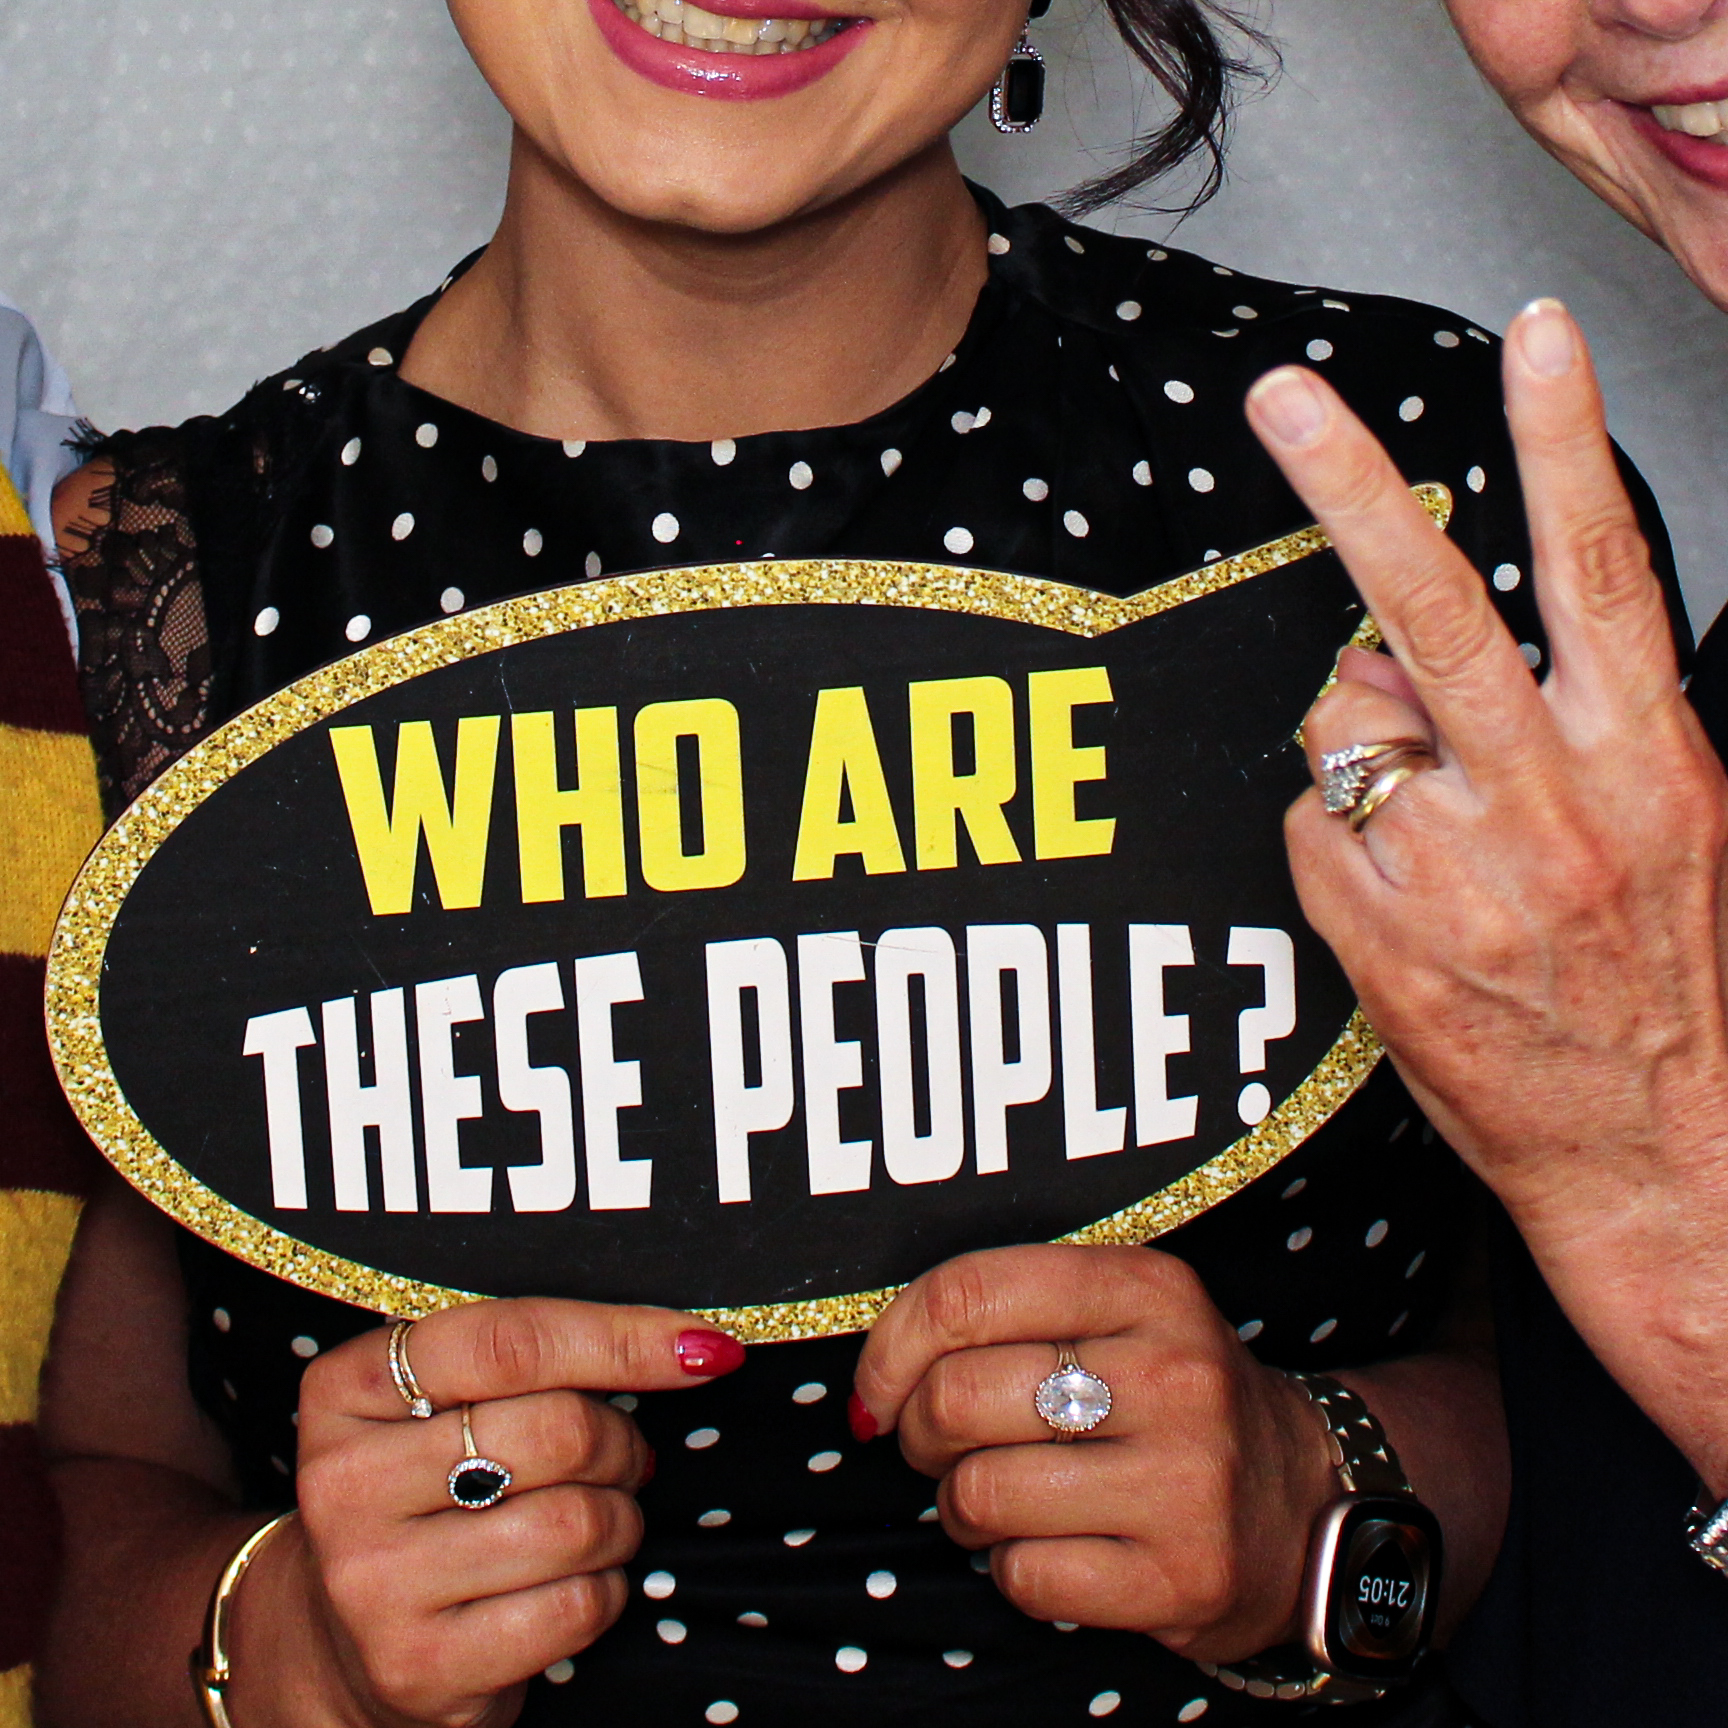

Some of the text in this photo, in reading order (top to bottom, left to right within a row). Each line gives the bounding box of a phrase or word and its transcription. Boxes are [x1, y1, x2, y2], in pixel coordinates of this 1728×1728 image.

[328, 666, 1117, 915] WHO ARE
[242, 923, 1296, 1212] THESE PEOPLE?
[1358, 1575, 1410, 1607] 21:05
